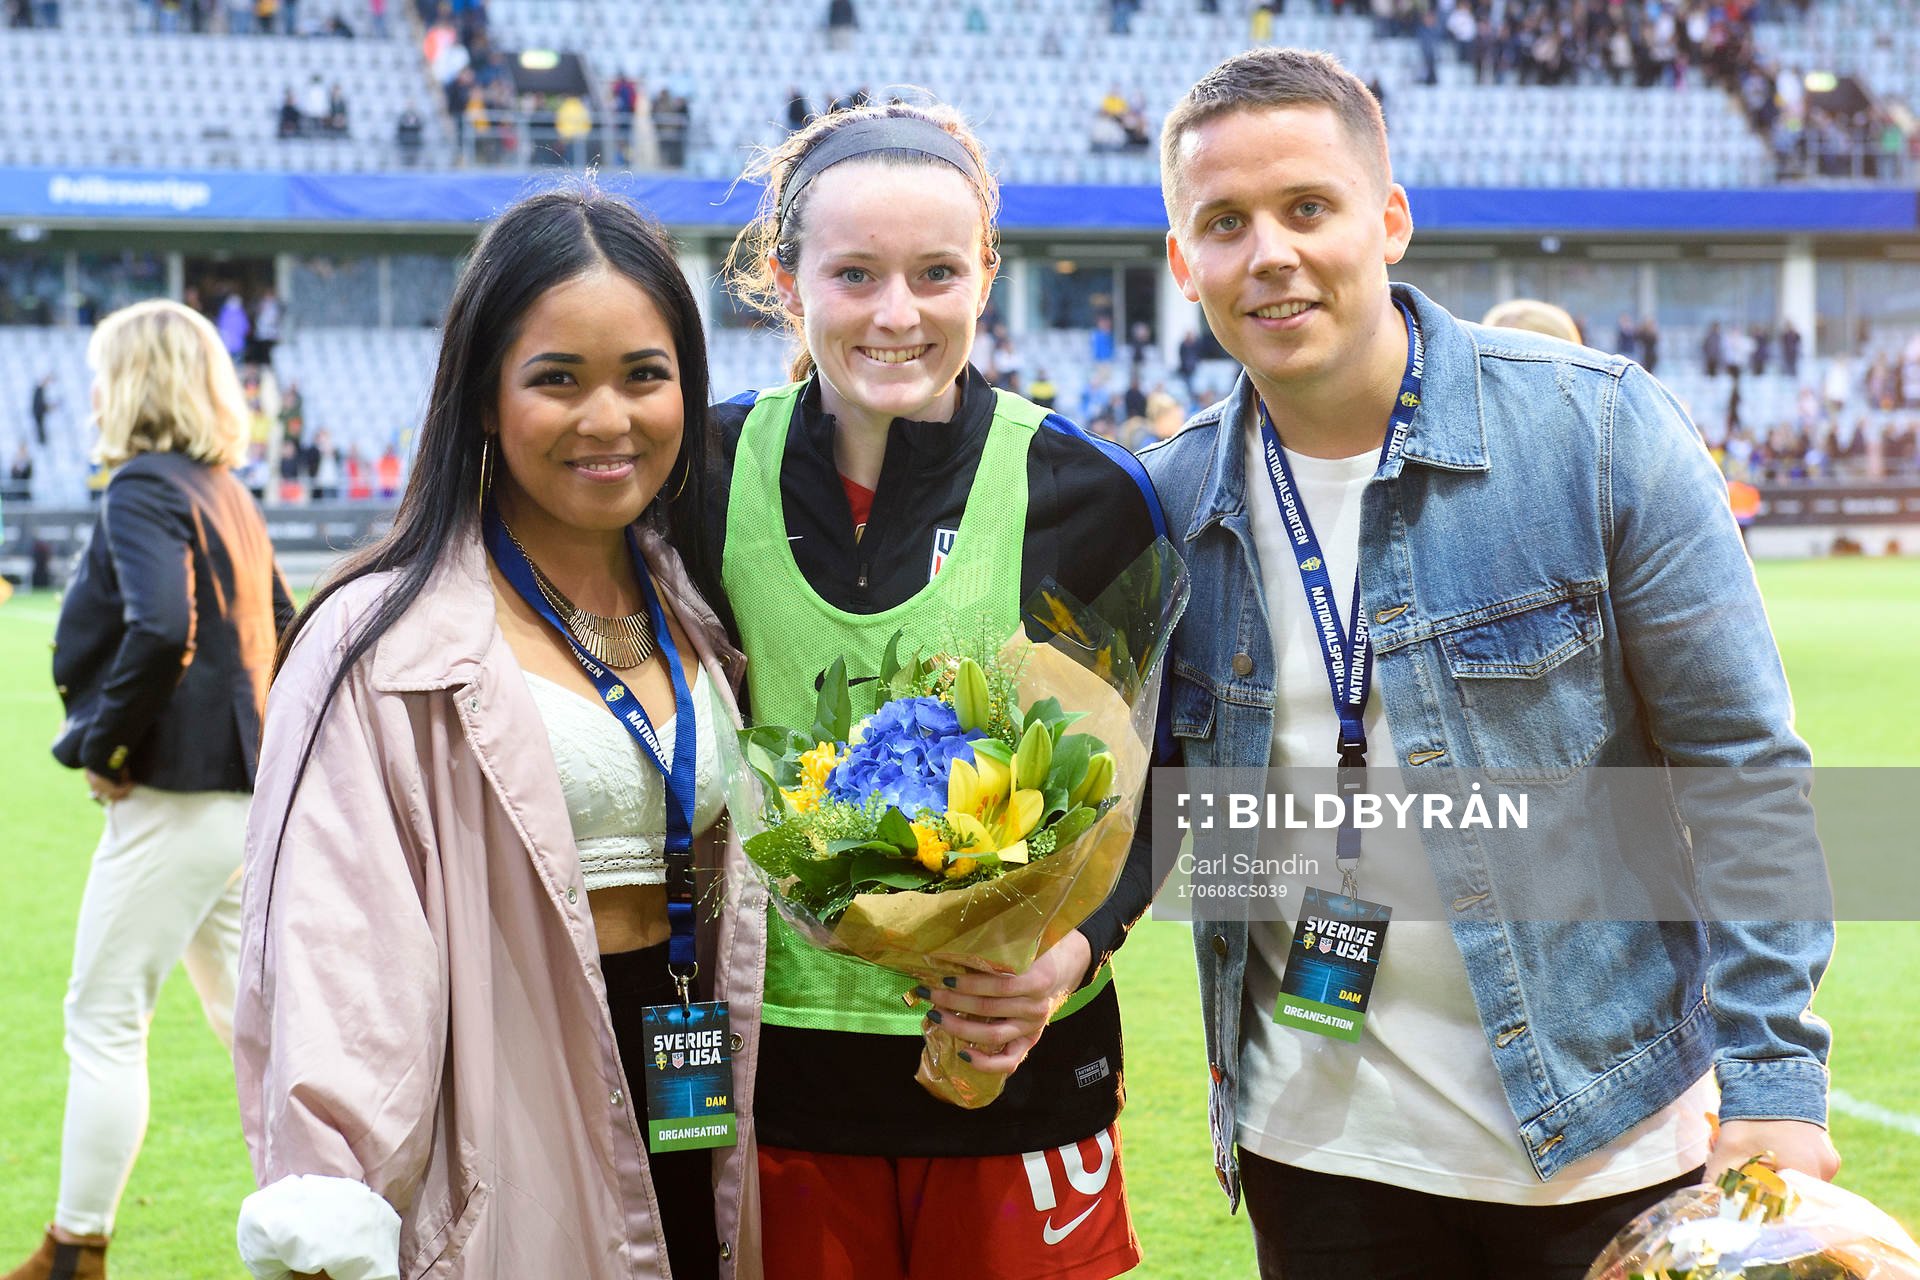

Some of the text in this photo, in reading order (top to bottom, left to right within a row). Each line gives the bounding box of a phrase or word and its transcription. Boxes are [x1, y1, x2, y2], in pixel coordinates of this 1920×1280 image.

[1386, 421, 1409, 461] ORTEN
[1266, 439, 1309, 546] NATIONALSPORTEN
[568, 640, 604, 679] ORTEN
[626, 710, 672, 775] NATIONAL
[1304, 915, 1377, 947] SVERIGE
[1336, 940, 1369, 963] USA
[1338, 989, 1362, 1004] DAM
[1283, 1004, 1354, 1031] ORGANISATION
[653, 1030, 723, 1052] SVERIGE
[689, 1048, 722, 1066] USA
[705, 1096, 727, 1107] DAM
[658, 1125, 728, 1141] ORGANISATION
[1021, 1128, 1115, 1212] 10
